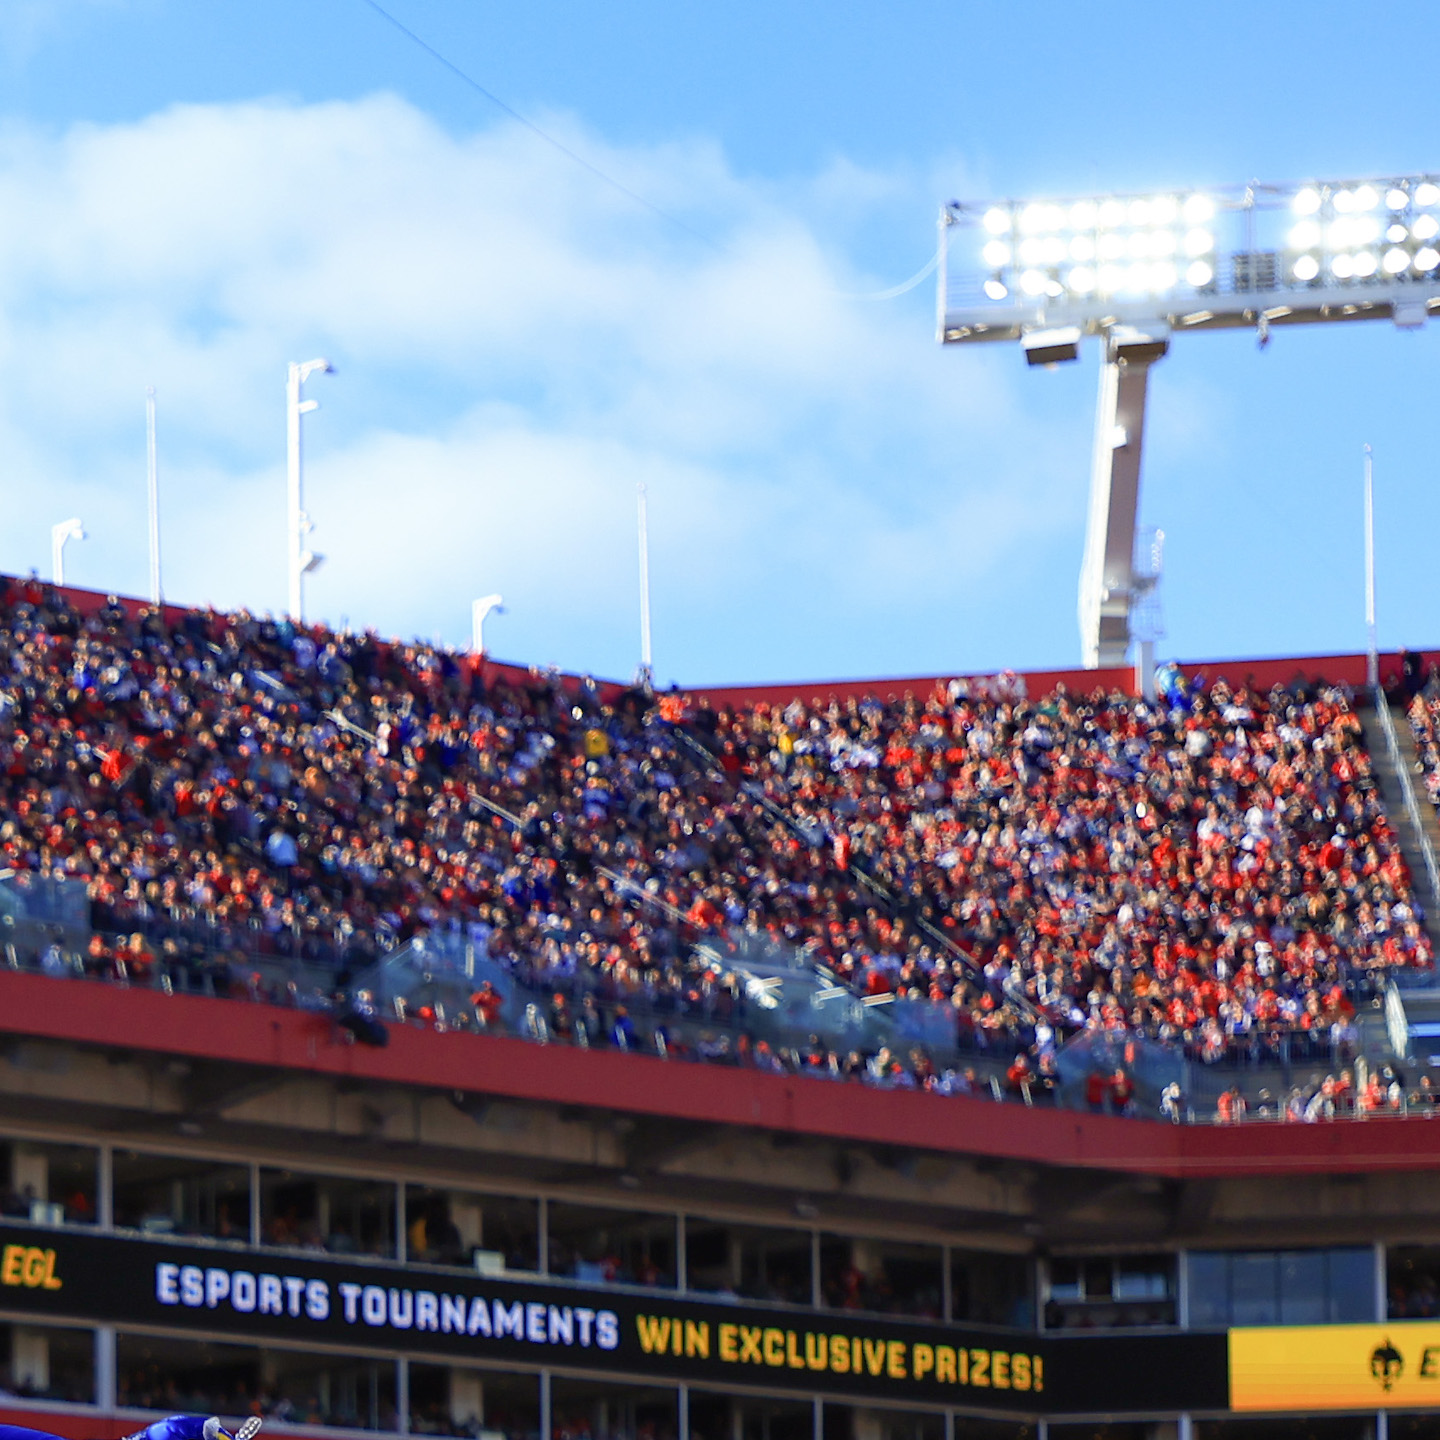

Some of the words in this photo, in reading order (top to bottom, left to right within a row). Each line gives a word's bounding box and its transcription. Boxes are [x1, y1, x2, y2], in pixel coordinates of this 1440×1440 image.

[1, 1244, 62, 1291] EGL
[155, 1261, 330, 1320] ESPORTS
[337, 1281, 620, 1350] TOURNAMENTS
[635, 1313, 710, 1359] WIN
[719, 1321, 908, 1380] EXCLUSIVE
[912, 1342, 1045, 1393] PRIZES!
